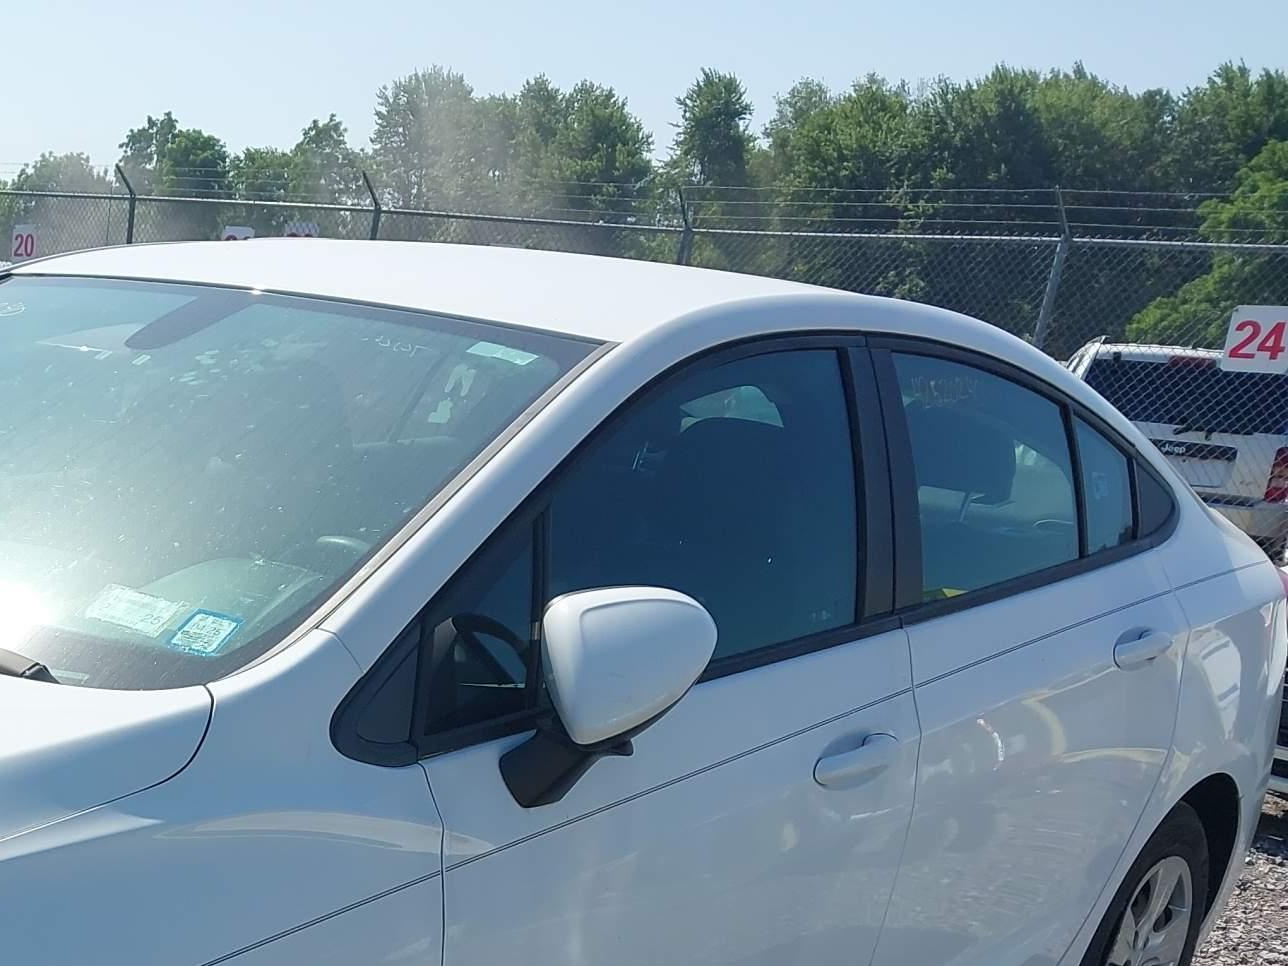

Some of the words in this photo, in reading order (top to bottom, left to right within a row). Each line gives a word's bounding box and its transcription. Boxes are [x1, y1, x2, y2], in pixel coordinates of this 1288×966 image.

[13, 233, 35, 257] 20
[1228, 320, 1287, 360] 24
[1161, 442, 1186, 454] Jeep
